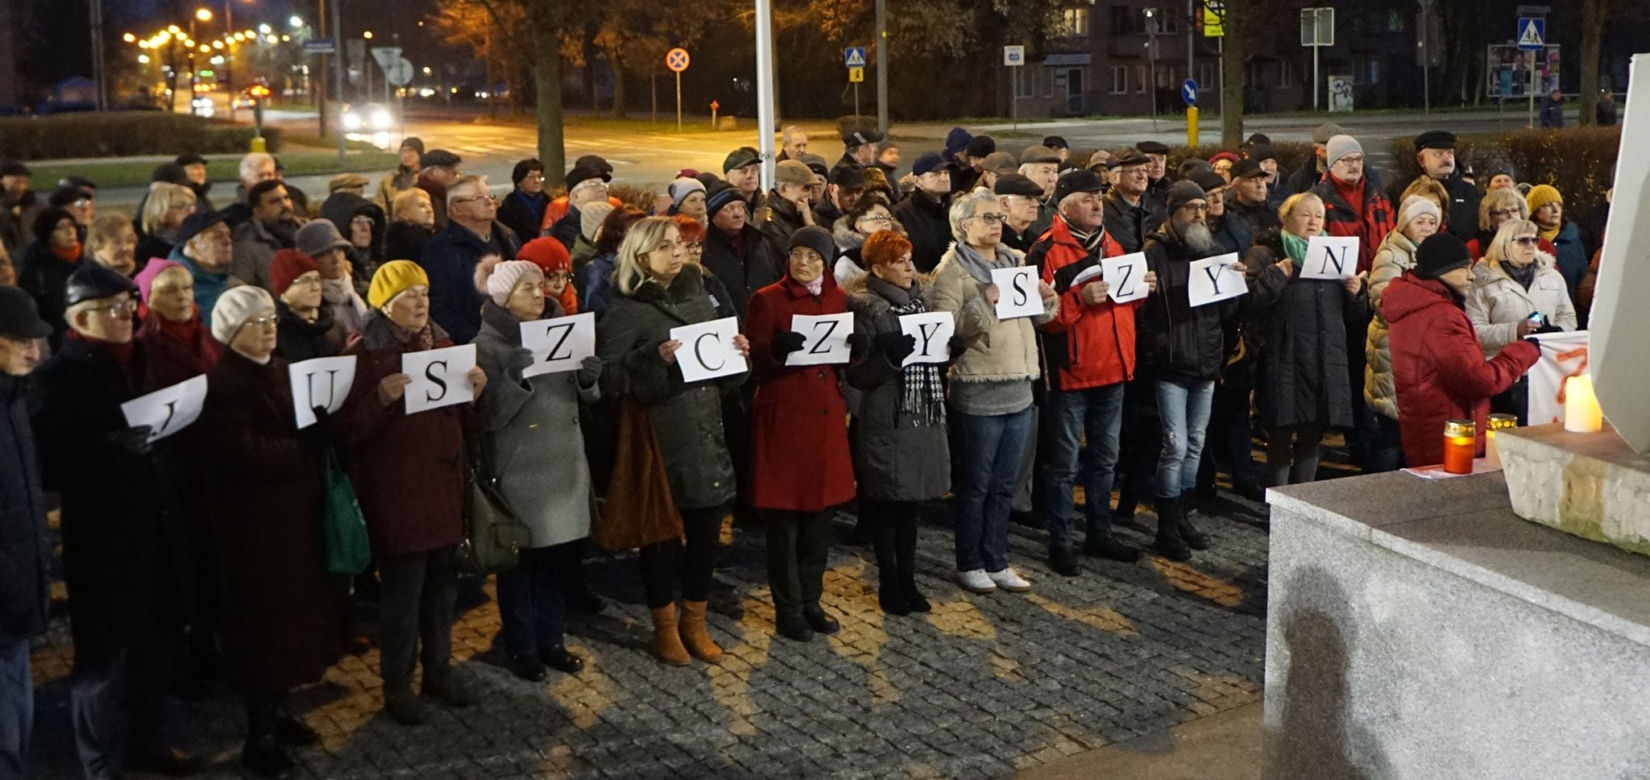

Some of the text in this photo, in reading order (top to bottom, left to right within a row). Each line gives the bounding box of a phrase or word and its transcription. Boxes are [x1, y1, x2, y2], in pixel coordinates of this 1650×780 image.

[1320, 245, 1349, 276] N
[1013, 272, 1029, 307] S
[1115, 264, 1134, 298] Z
[1203, 263, 1228, 296] Y
[545, 322, 577, 363] Z
[693, 331, 726, 372] C
[809, 320, 840, 355] Z
[918, 322, 944, 357] Y
[306, 369, 339, 413] U
[425, 360, 449, 402] S
[151, 399, 178, 437] J
